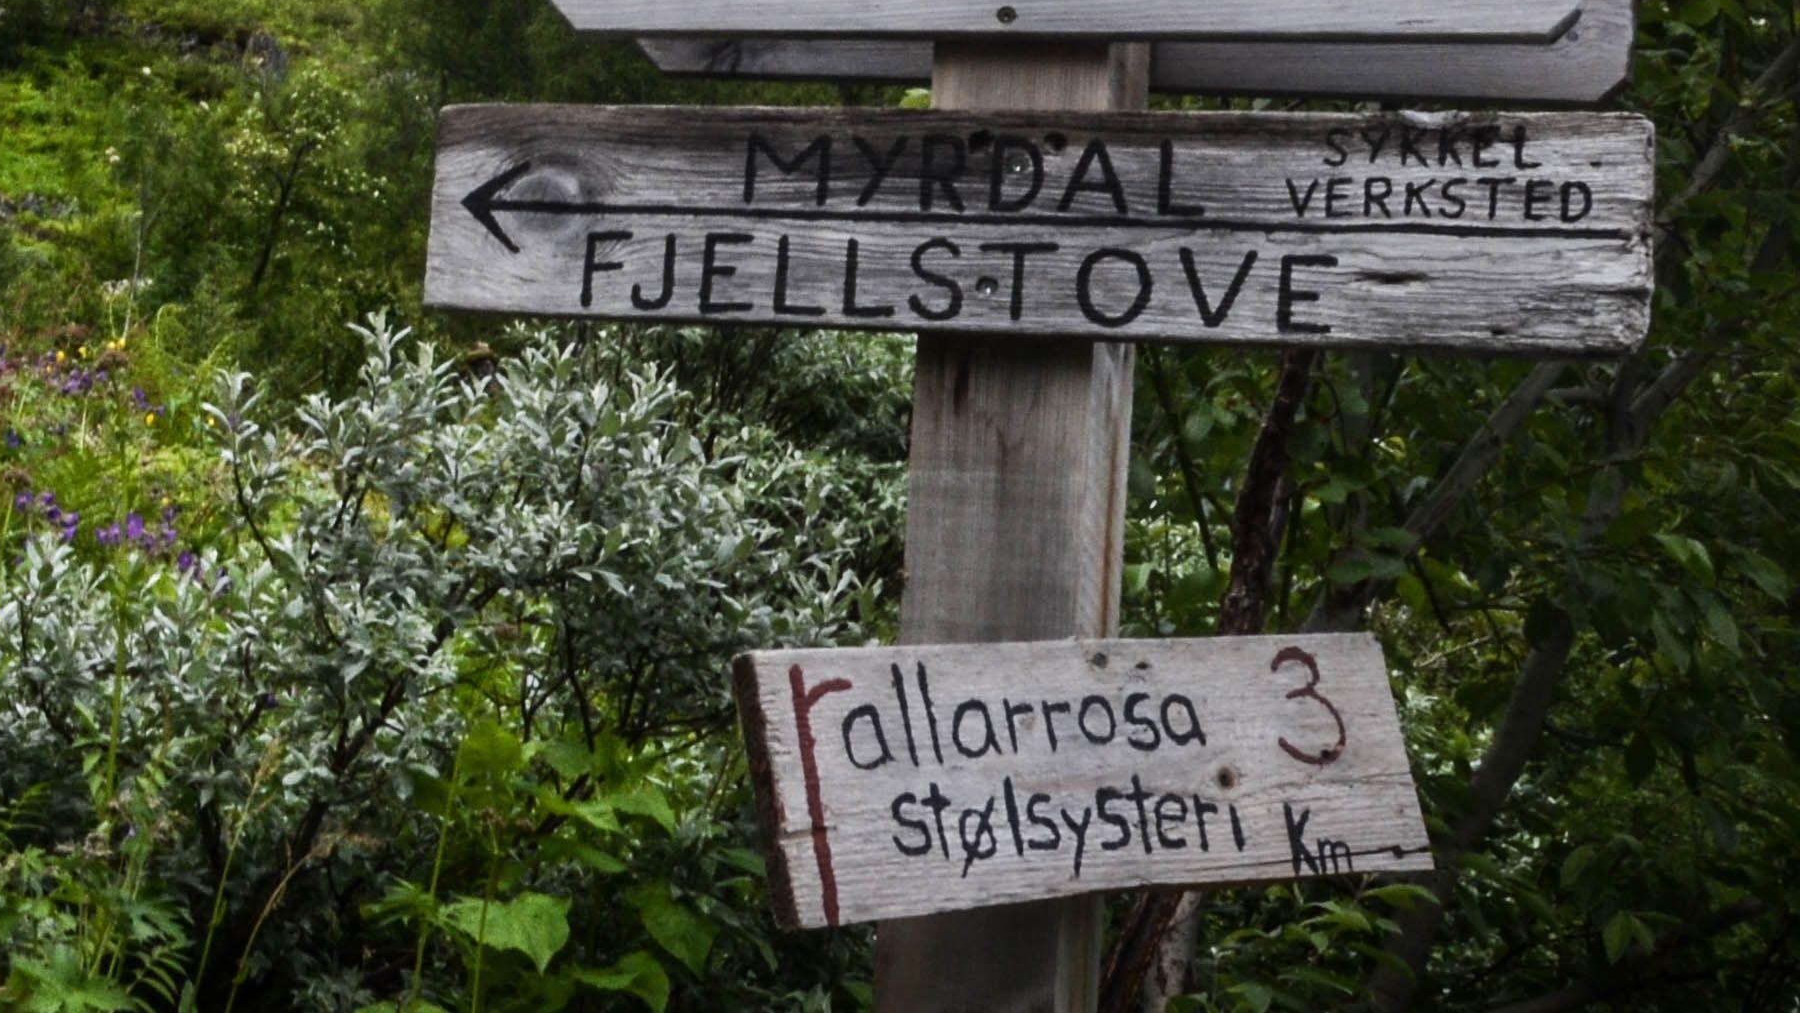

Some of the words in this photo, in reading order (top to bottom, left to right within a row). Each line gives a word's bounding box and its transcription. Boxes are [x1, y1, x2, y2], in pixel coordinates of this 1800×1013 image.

[742, 131, 1205, 217] MYRDAL
[1285, 176, 1593, 224] VERKSTED
[579, 230, 1340, 334] FJELLSTOVE
[788, 661, 1207, 927] rallarrosa
[1270, 645, 1347, 766] 3
[890, 772, 1246, 879] stølsysteri
